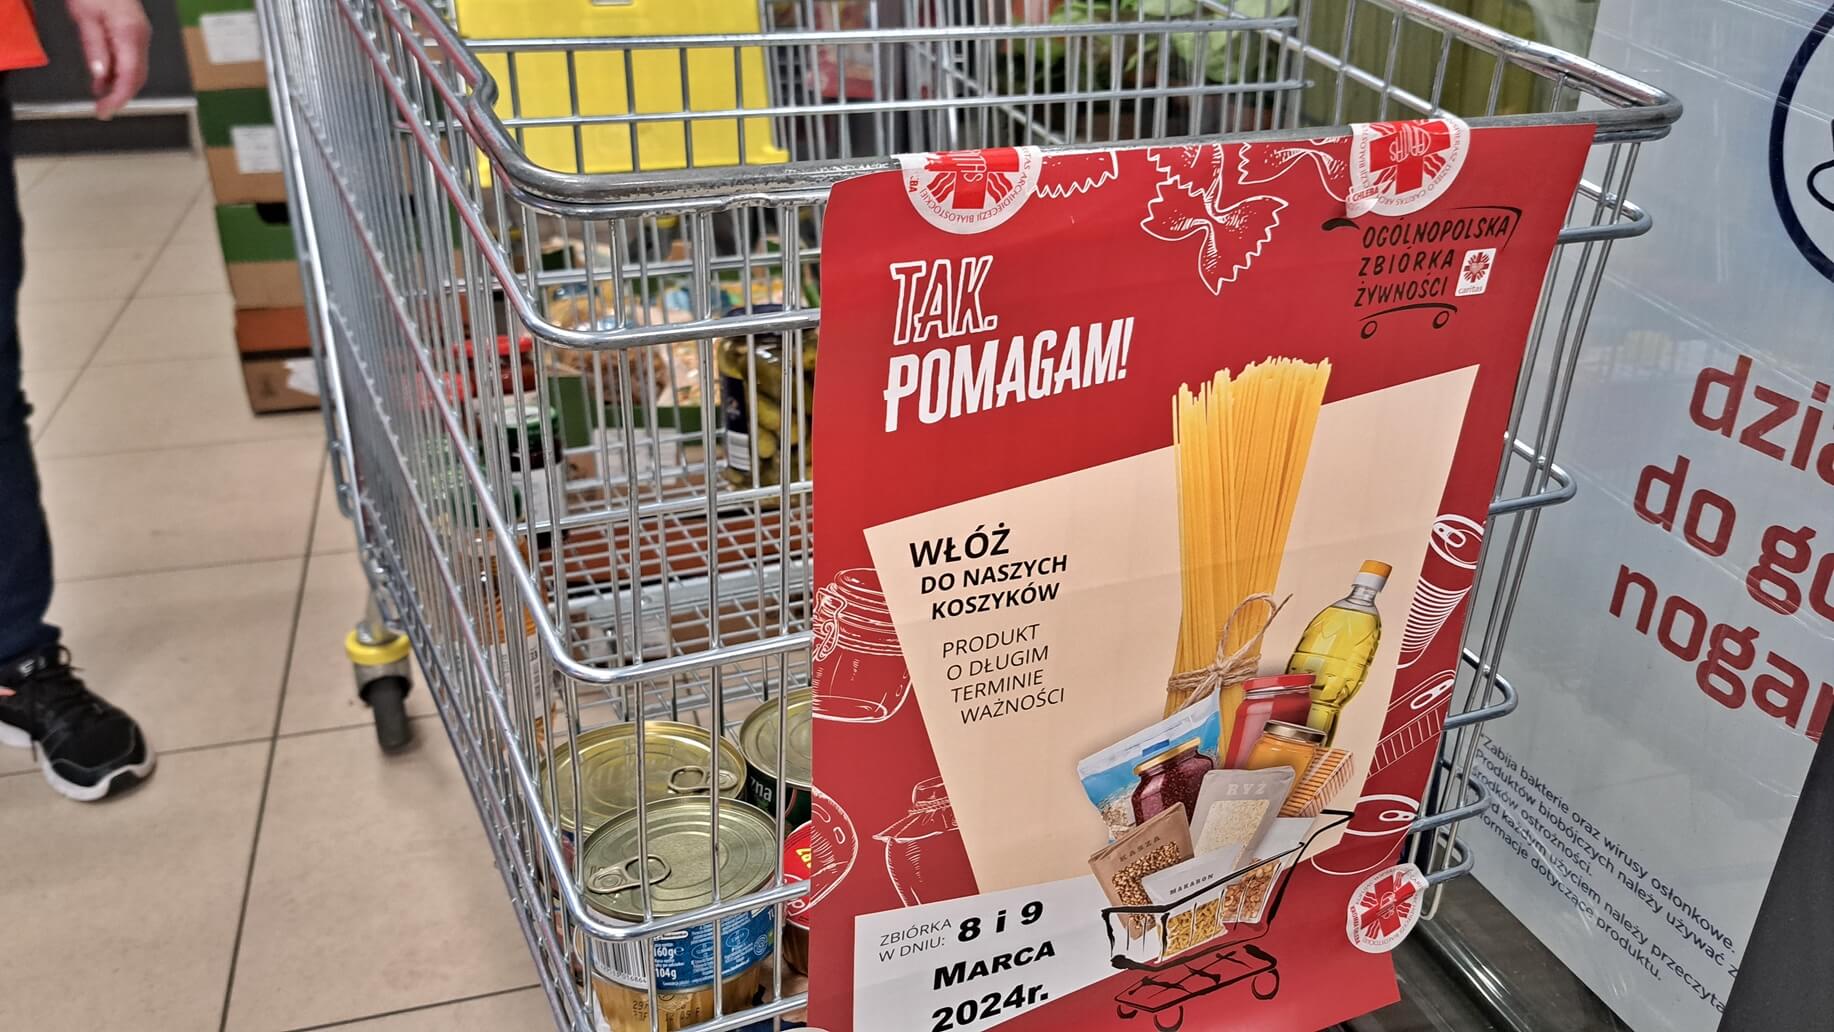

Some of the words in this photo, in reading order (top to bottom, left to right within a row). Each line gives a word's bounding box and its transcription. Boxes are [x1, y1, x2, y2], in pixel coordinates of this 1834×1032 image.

[1362, 216, 1510, 249] OGÓLNOPOLSKA
[1358, 247, 1455, 277] ZBIÓRKA
[890, 255, 998, 345] TAK.
[1354, 272, 1448, 307] ŻYWNOŚCI
[884, 317, 1135, 432] POMAGAM!
[1633, 454, 1736, 557] do
[909, 522, 1011, 568] WŁÓŻ
[921, 573, 955, 595] DO
[963, 555, 1068, 588] NASZYCH
[932, 582, 1060, 620] KOSZYKÓW
[943, 623, 1041, 658] PRODUKT
[947, 664, 962, 681] O
[969, 645, 1049, 677] DŁUGIM
[951, 669, 1044, 703] TERMINIE
[961, 688, 1065, 724] WAŻNOŚCI
[1119, 835, 1161, 863] KASZA
[1520, 766, 1569, 814] bakterie
[1572, 811, 1600, 841] oraz
[1604, 836, 1648, 879] wirusy
[1651, 877, 1735, 954] osłonkowe.
[1521, 809, 1593, 876] ostrożności.
[1501, 809, 1548, 858] każdym
[1549, 854, 1600, 904] użyciem
[1604, 901, 1649, 945] należy
[1538, 801, 1615, 873] biobójczych
[1617, 870, 1663, 914] należy
[1666, 911, 1725, 966] używać
[879, 918, 952, 947] ZBIÓRKA
[958, 917, 982, 942] 8
[995, 909, 1007, 933] i
[1020, 901, 1043, 925] 9
[1530, 857, 1594, 918] dotyczące
[1596, 917, 1662, 981] produktu.
[879, 951, 895, 962] W
[900, 936, 946, 957] DNIU:
[933, 940, 1056, 990] MARCA
[656, 968, 678, 980] 104g
[931, 983, 1049, 1032] 2024r.
